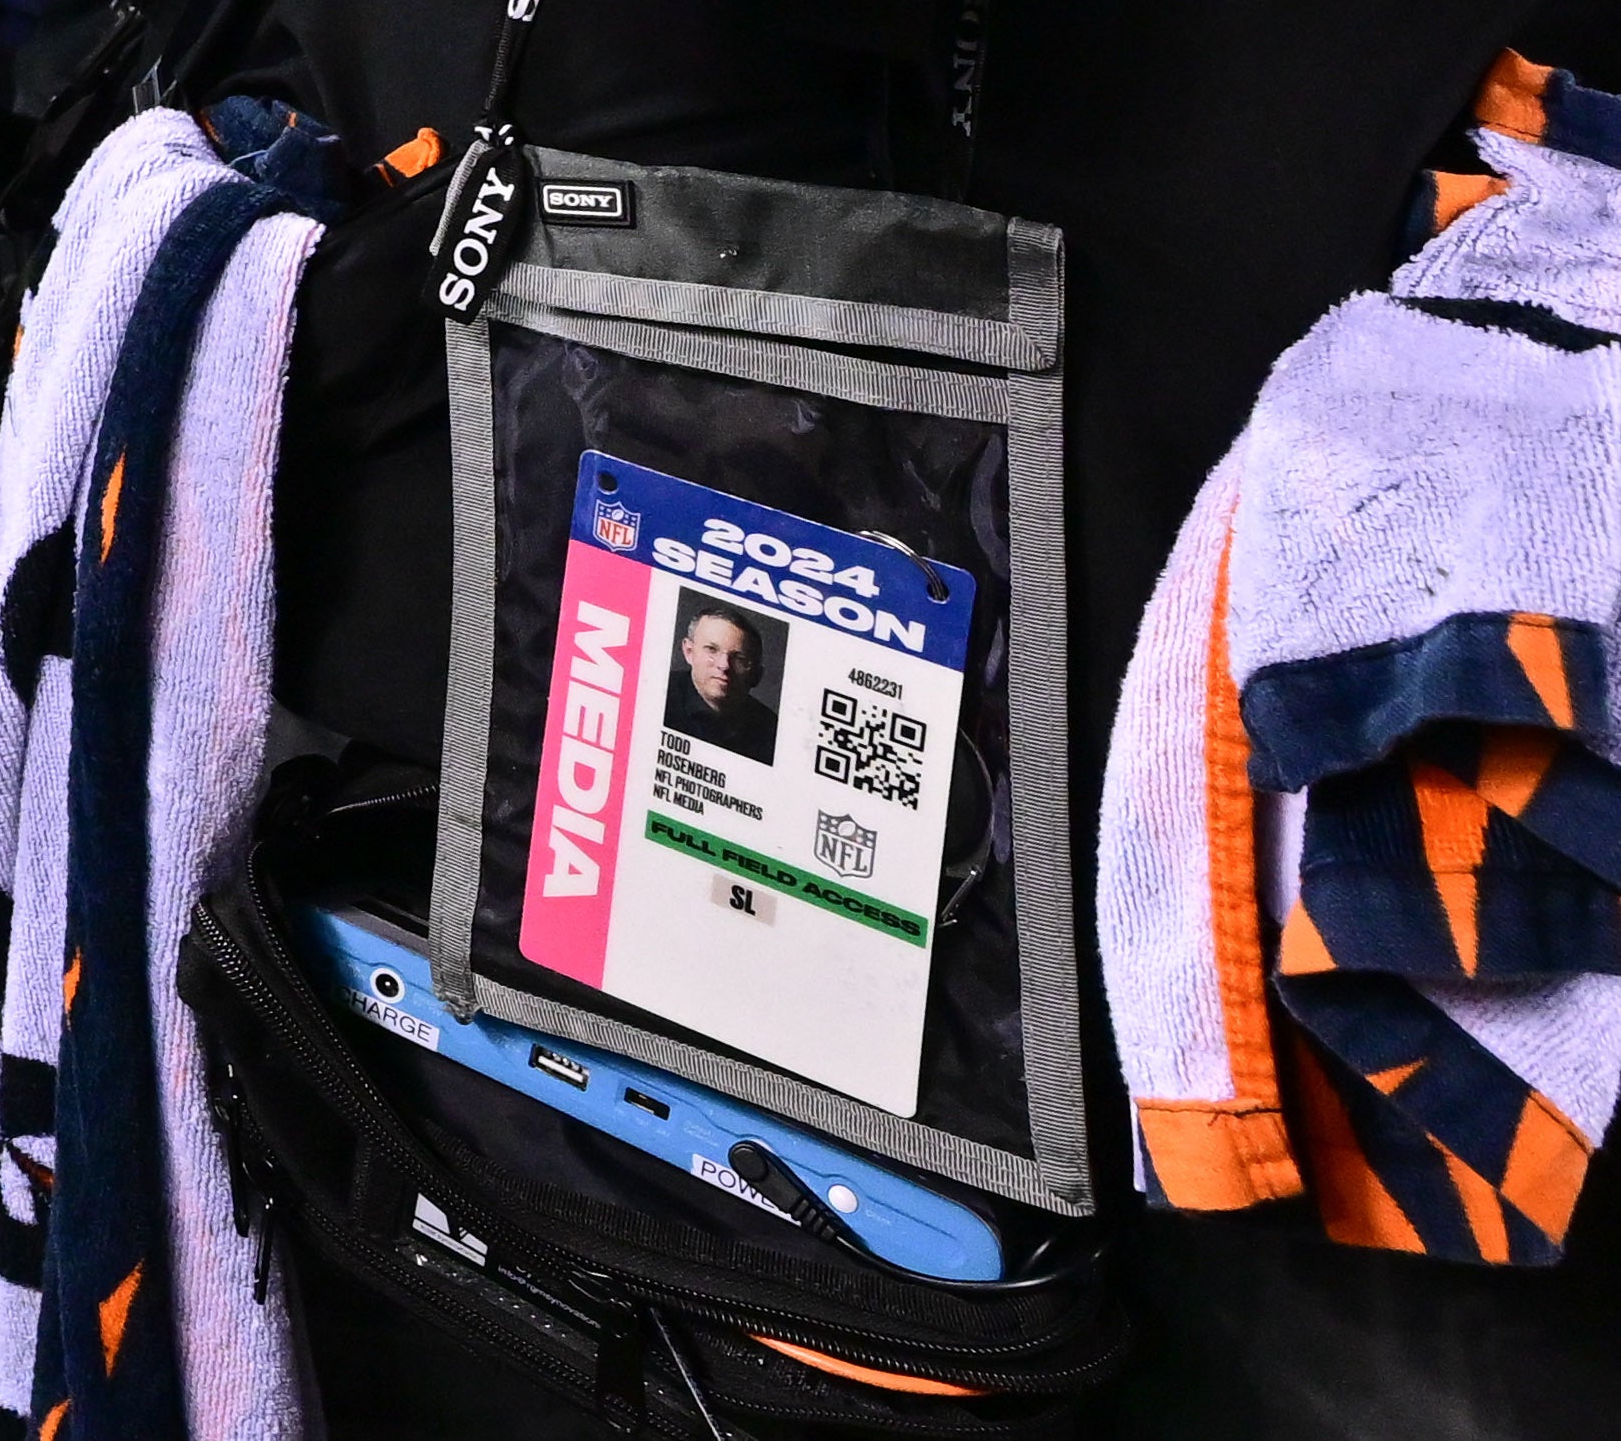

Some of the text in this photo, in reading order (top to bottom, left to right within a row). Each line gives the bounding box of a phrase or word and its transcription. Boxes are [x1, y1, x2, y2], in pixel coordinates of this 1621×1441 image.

[548, 192, 614, 208] SONY
[439, 166, 515, 313] SONY
[597, 519, 632, 547] NFL
[701, 518, 881, 600] 2024
[650, 536, 927, 655] SEASON
[847, 667, 904, 700] 4862231
[542, 600, 631, 898] MEDIA
[660, 730, 691, 756] TODD
[656, 749, 727, 789] ROSENBERG
[652, 783, 705, 817] NFL MEDIA
[654, 768, 764, 821] NFL PHOTOGRAPHERS
[819, 831, 869, 874] NFL
[651, 819, 921, 937] FULL FIELD ACCESS
[729, 884, 756, 917] SL
[340, 987, 433, 1044] CHARGE
[700, 1159, 777, 1210] POW
